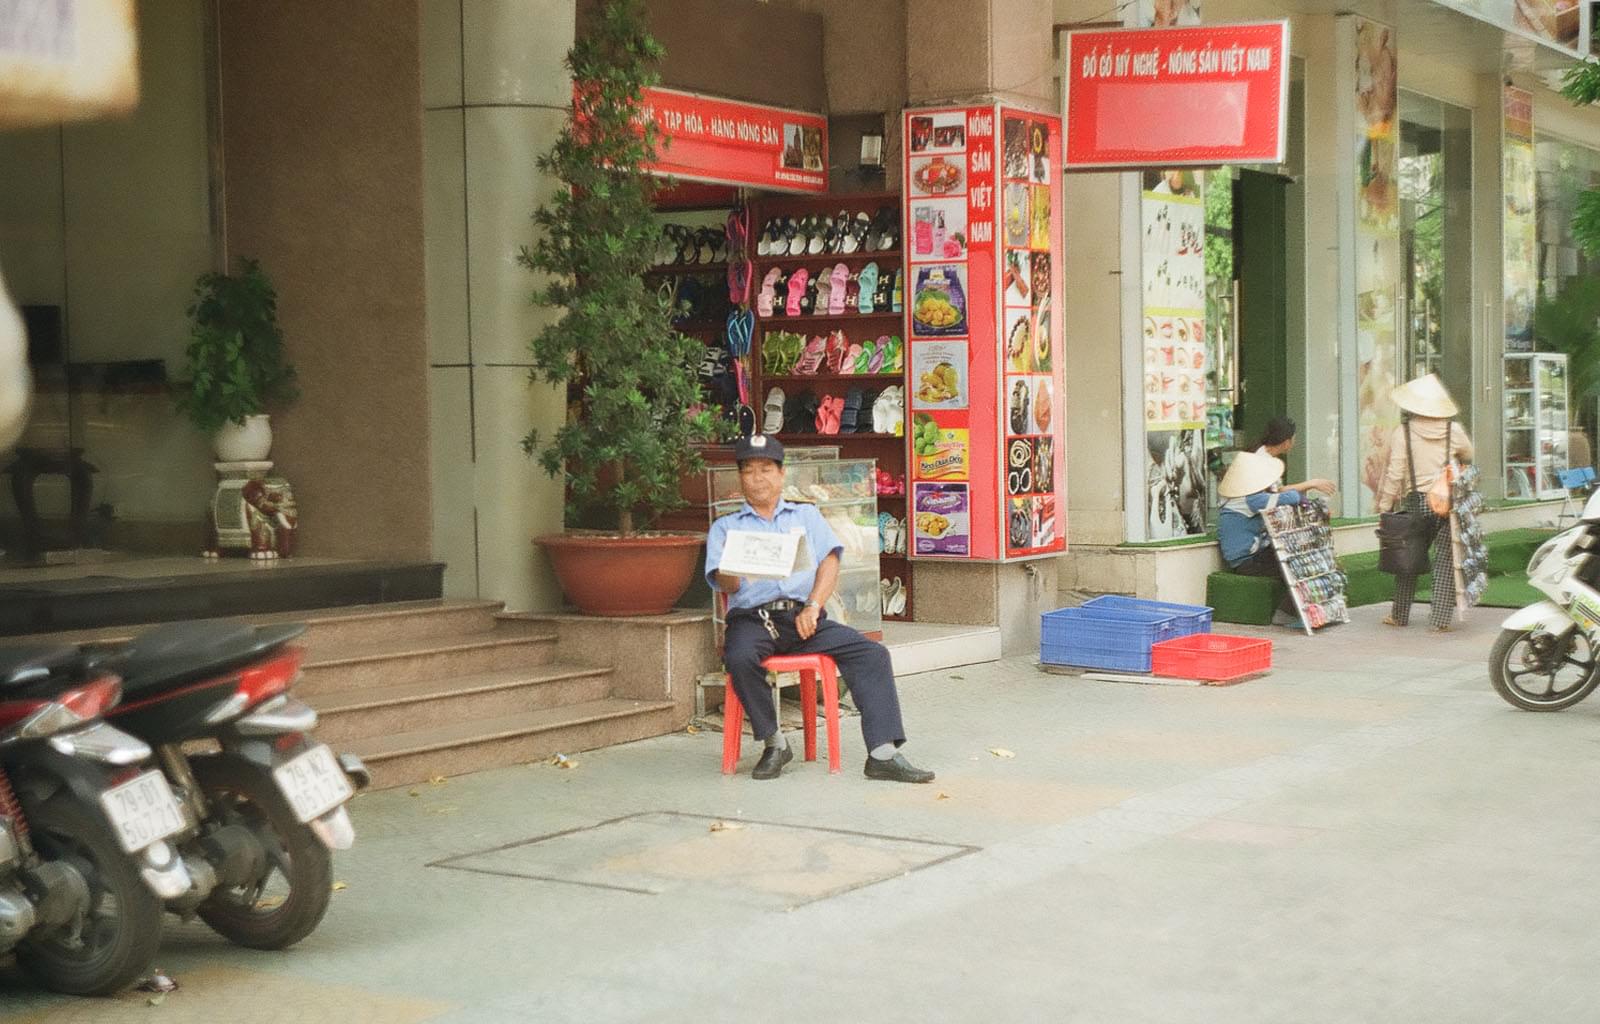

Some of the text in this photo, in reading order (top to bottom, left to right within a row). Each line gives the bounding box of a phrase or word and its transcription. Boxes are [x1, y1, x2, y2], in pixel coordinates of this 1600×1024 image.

[1168, 43, 1197, 74] NÔNG
[1199, 41, 1219, 74] SẢN
[1221, 42, 1245, 76] VIỆT
[1247, 48, 1270, 71] NAM
[663, 111, 682, 133] TẠP
[684, 110, 704, 134] HÓA
[711, 114, 736, 139] HÀNG
[737, 119, 760, 142] NÔNG
[762, 121, 779, 144] SẢN
[968, 111, 992, 137] NÔNG
[971, 144, 991, 172] SẢN
[971, 180, 993, 211] VIỆT
[971, 222, 993, 242] NAM
